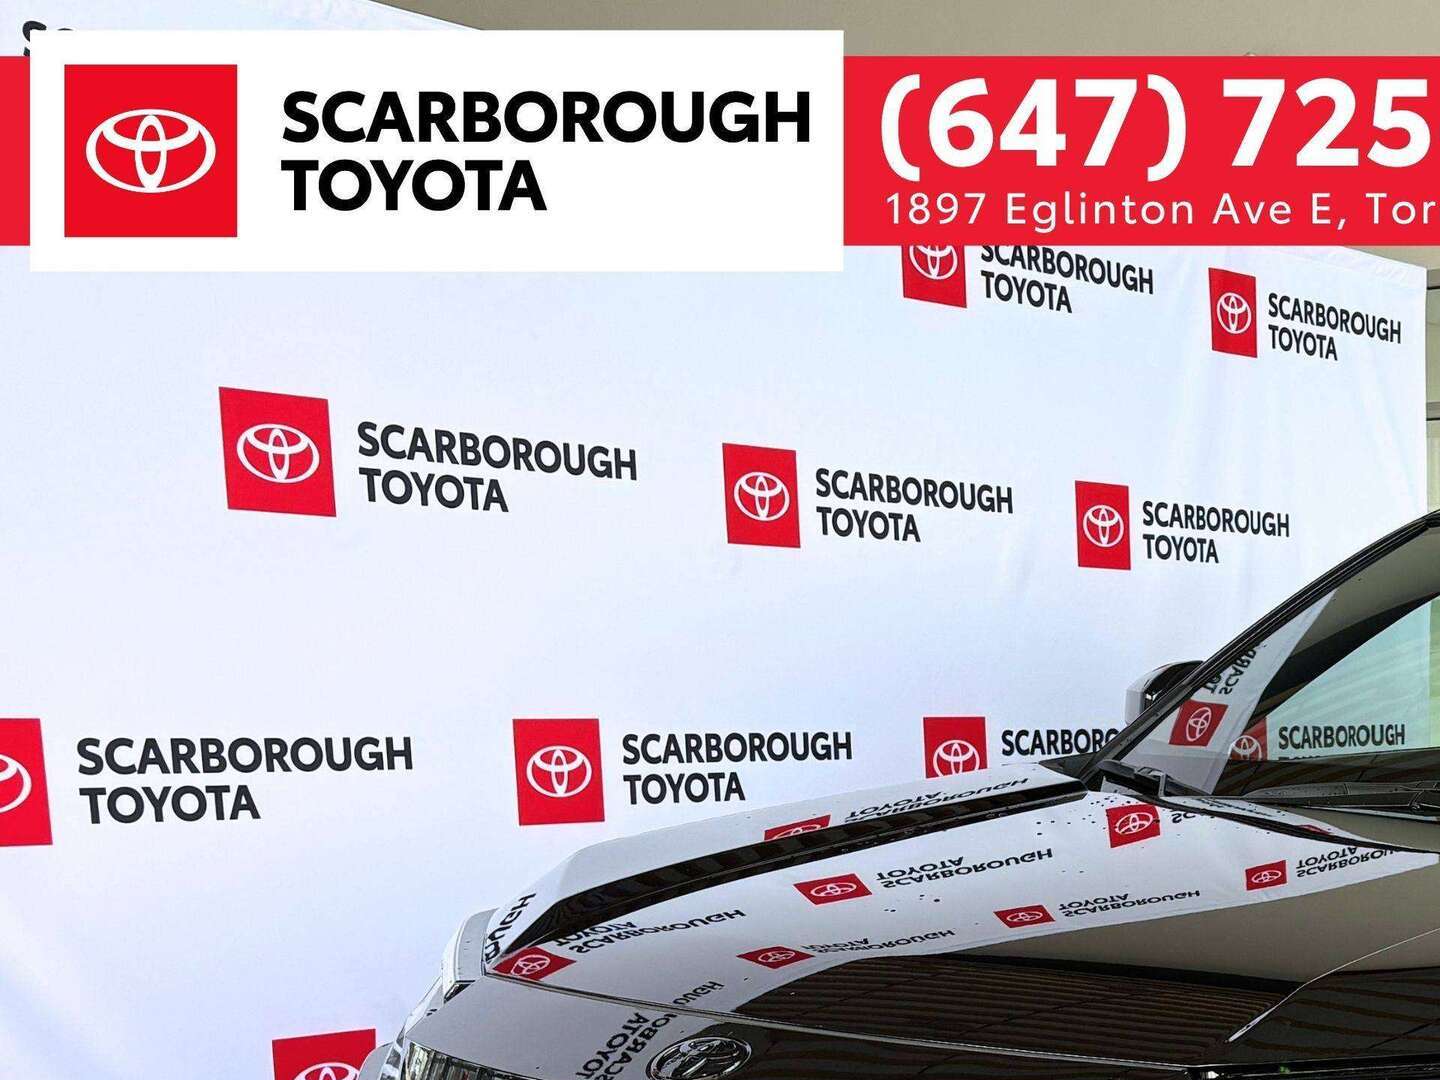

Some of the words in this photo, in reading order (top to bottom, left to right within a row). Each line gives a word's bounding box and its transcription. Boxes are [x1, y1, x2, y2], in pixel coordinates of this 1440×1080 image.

[980, 246, 1154, 295] SCARBOROUGH
[980, 269, 1073, 313] TOYOTA
[1267, 292, 1401, 346] SCARBOROUGH
[1268, 325, 1338, 361] TOYOTA
[357, 421, 638, 482] SCARBOROUGH
[358, 467, 509, 513] TOYOTA
[815, 467, 1013, 515] SCARBOROUGH
[816, 506, 921, 543] TOYOTA
[1142, 500, 1290, 540] SCARBOROUGH
[1142, 533, 1219, 565] TOYOTA
[76, 735, 414, 777] SCARBOROUGH
[622, 730, 853, 766] SCARBOROUGH
[1278, 723, 1406, 751] SCARBOROUGH
[78, 784, 261, 825] TOYOTA
[622, 771, 746, 806] TOYOTA
